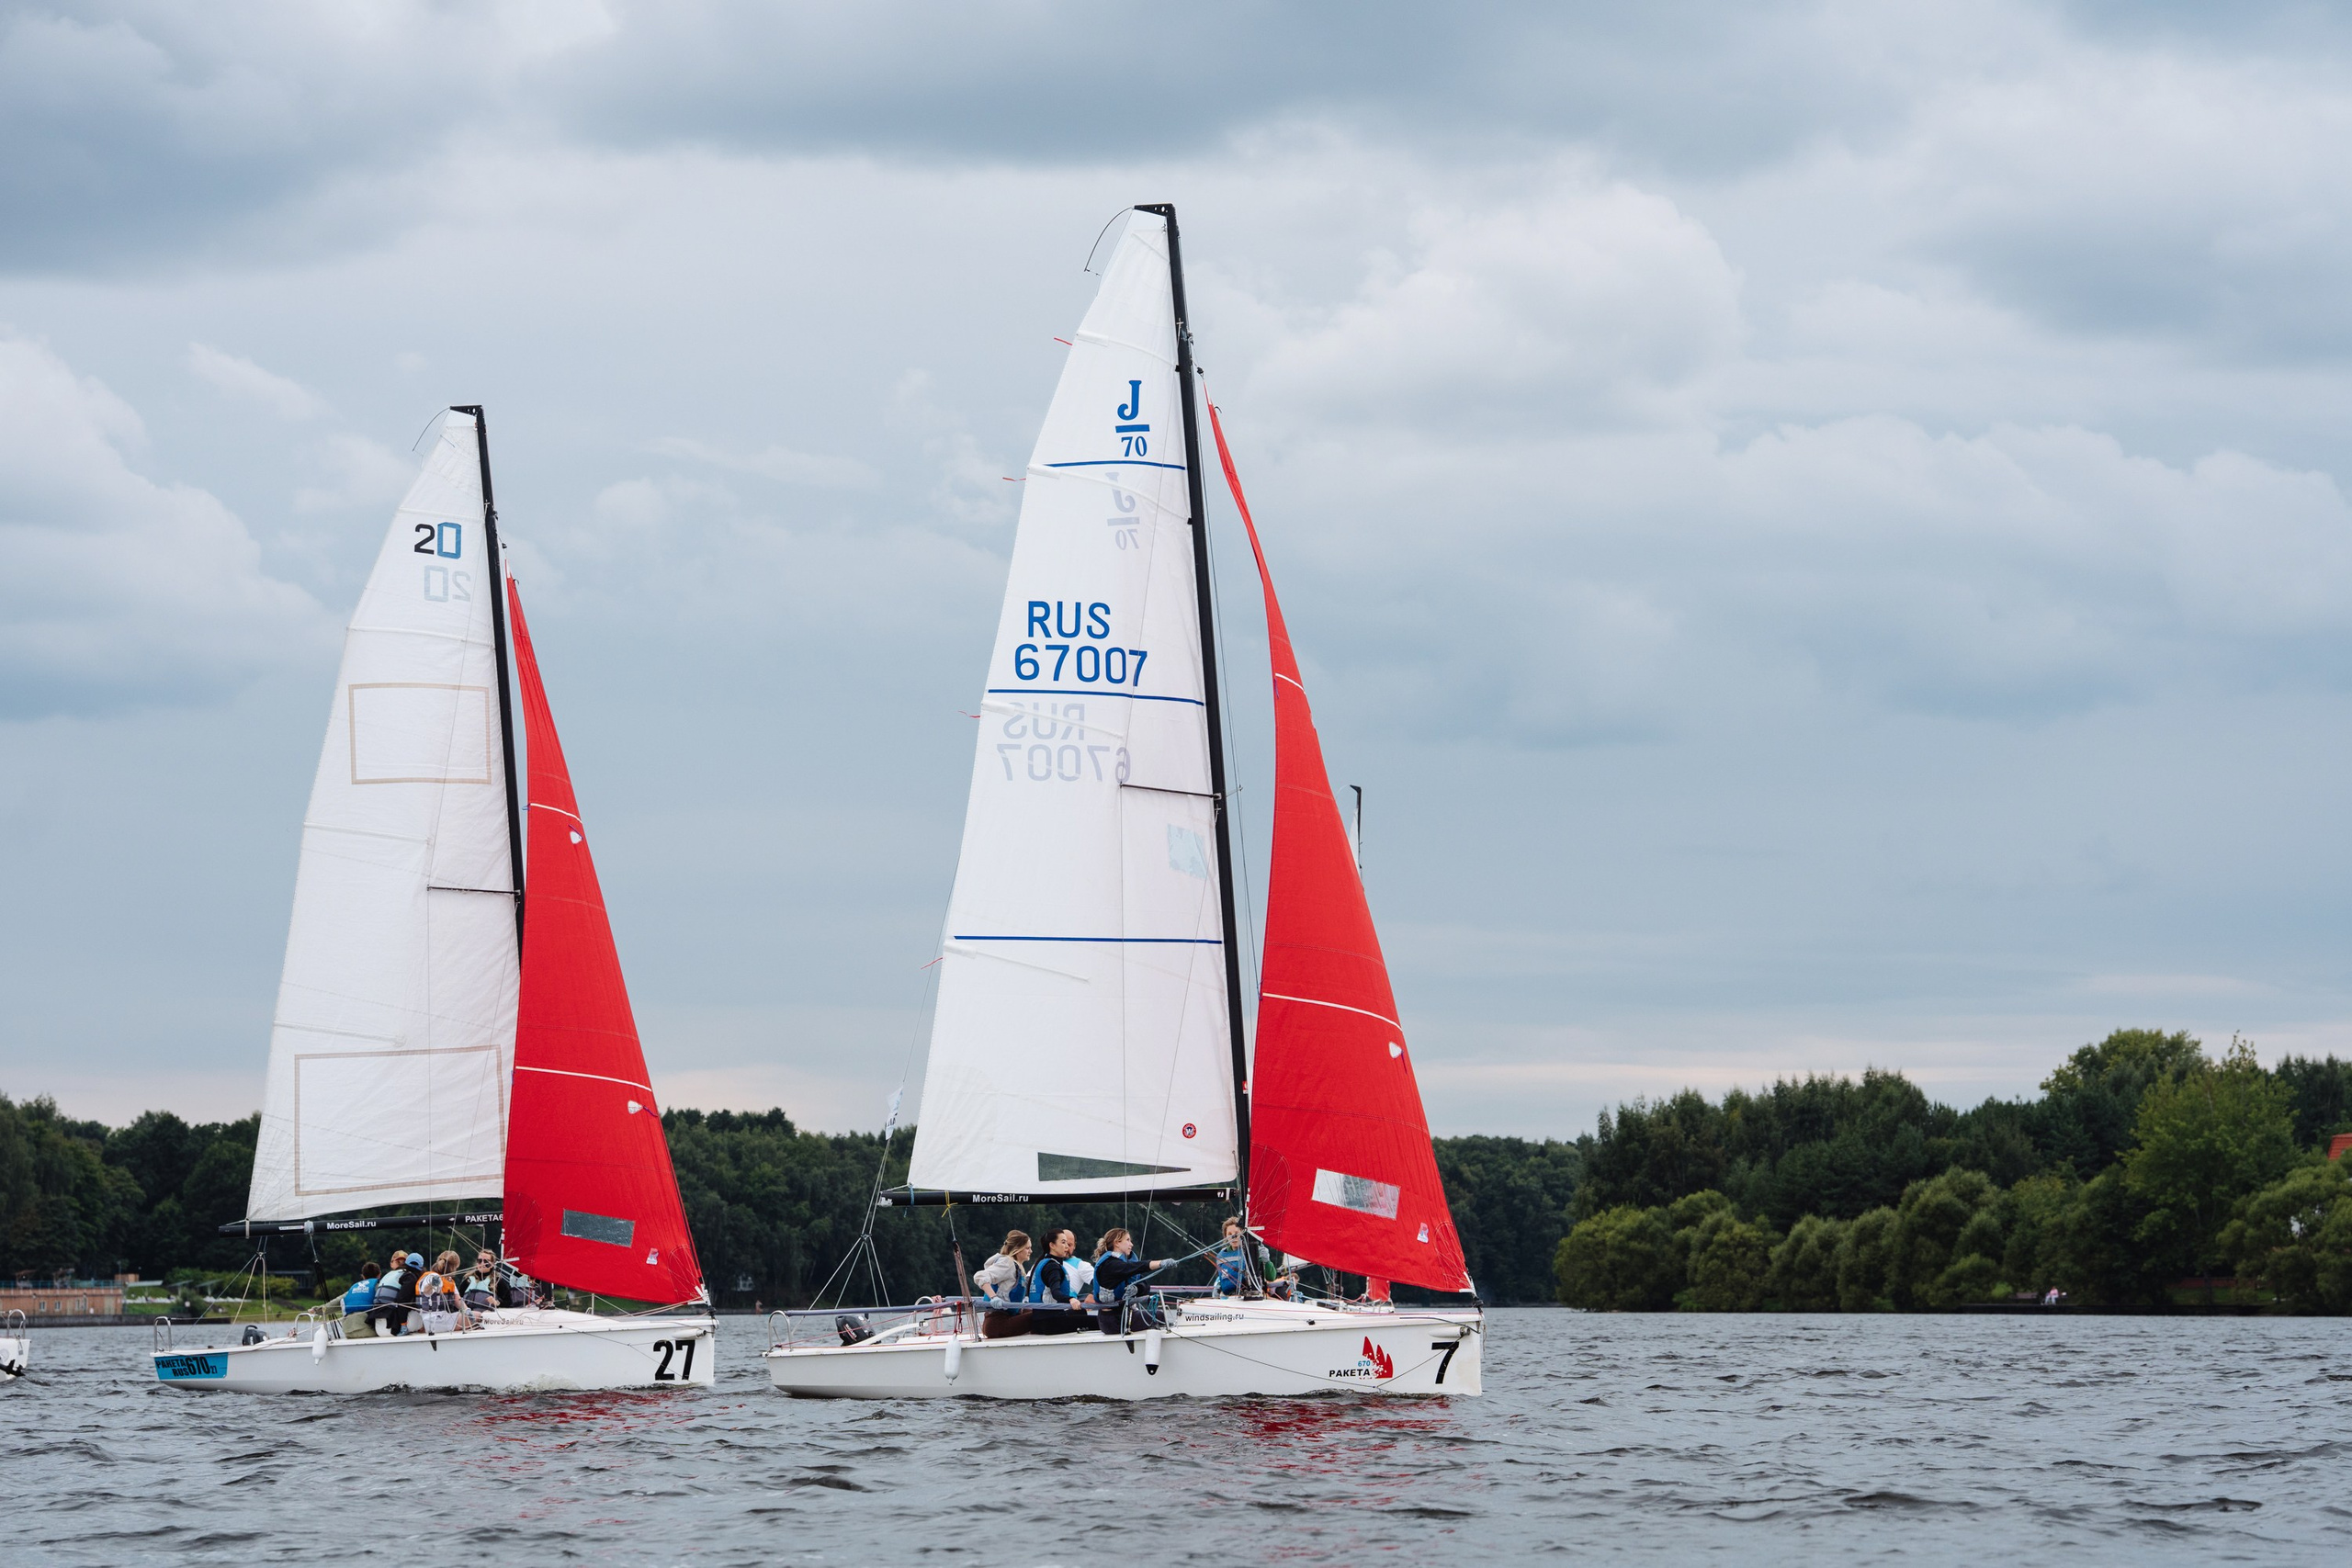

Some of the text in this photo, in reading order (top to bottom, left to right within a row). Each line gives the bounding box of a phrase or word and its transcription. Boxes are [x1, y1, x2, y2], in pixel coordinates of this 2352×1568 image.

[1117, 379, 1142, 421] J
[1121, 435, 1148, 457] 70
[413, 521, 462, 560] 20
[1027, 600, 1112, 640] RUS
[1014, 643, 1148, 687] 67007
[972, 1193, 1030, 1203] MoreSail.ru
[326, 1220, 377, 1230] MoreSail.ru
[1184, 1312, 1245, 1323] windsailing.ru
[172, 1366, 190, 1378] RUS
[185, 1356, 211, 1377] 670
[652, 1339, 696, 1382] 27
[1430, 1341, 1460, 1385] 7
